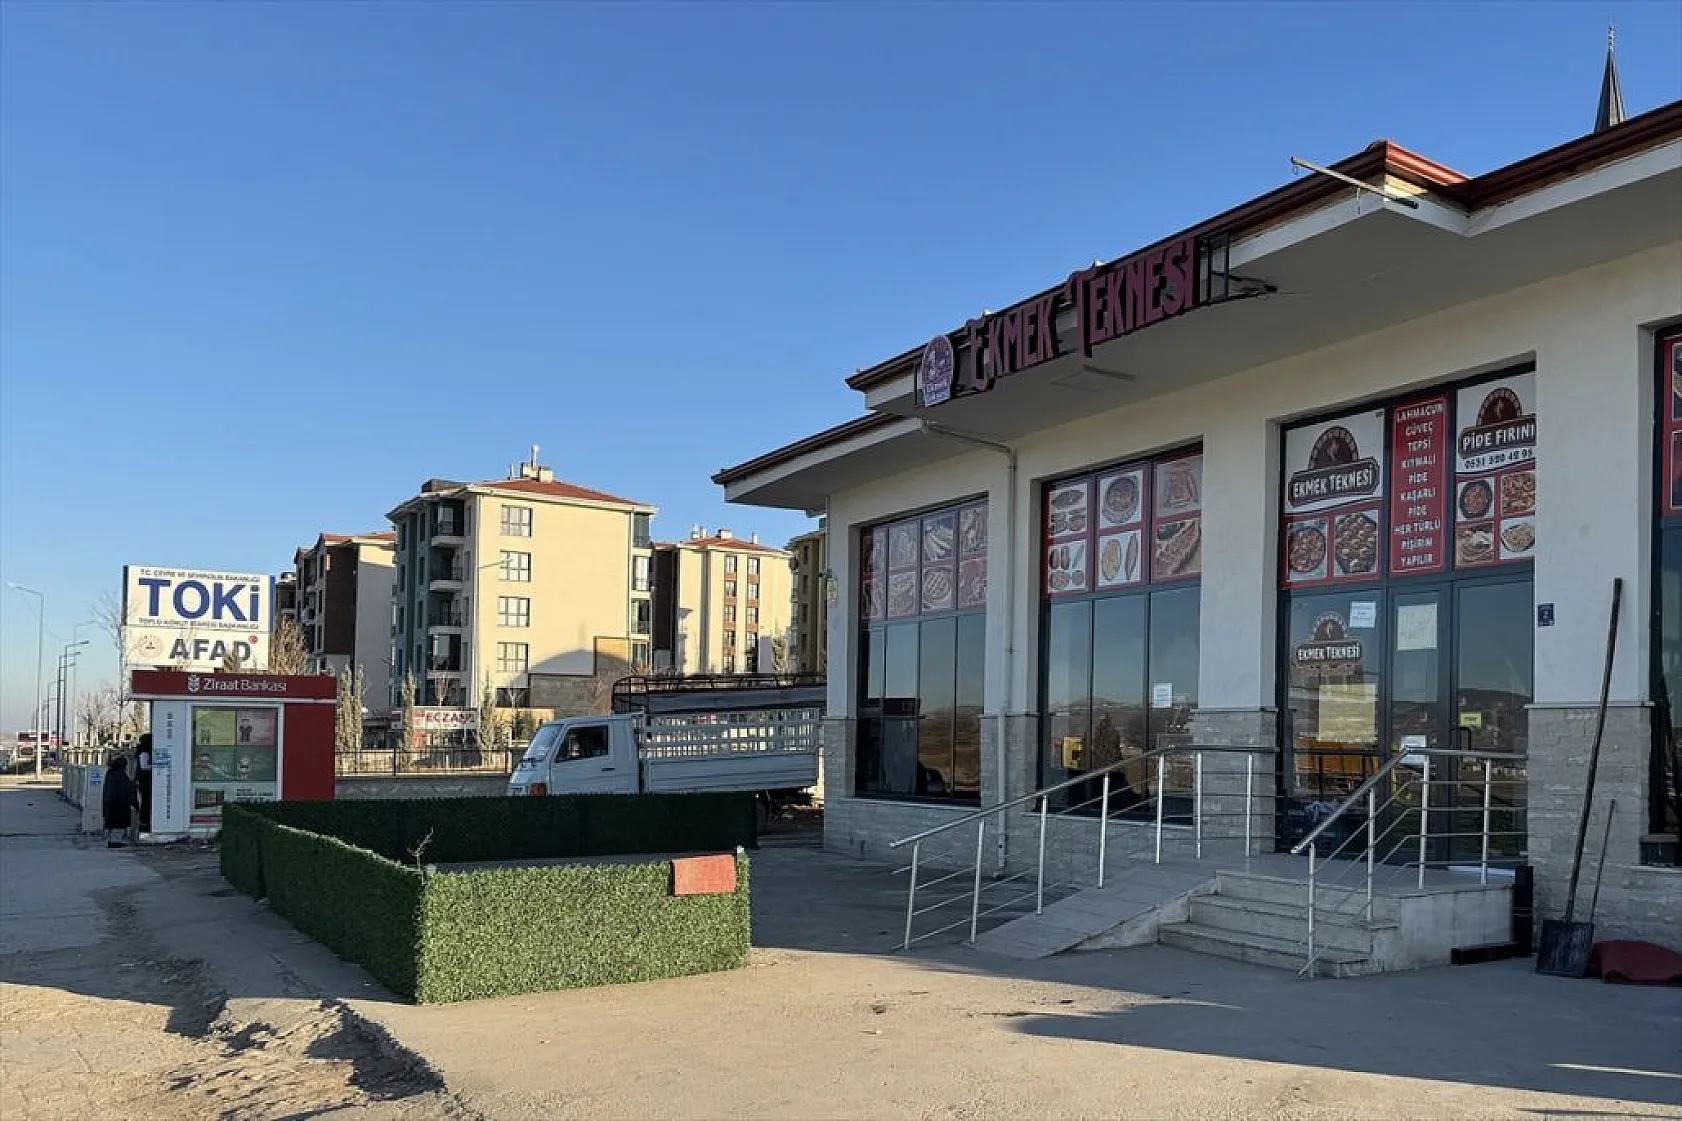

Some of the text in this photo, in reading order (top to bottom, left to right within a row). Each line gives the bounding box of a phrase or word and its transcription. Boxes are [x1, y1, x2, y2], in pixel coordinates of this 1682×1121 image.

[965, 300, 1057, 392] EKMEK
[1462, 431, 1492, 451] PİDE
[1293, 478, 1328, 499] EKMEK
[169, 638, 252, 662] AFAD
[203, 677, 240, 691] Ziraat
